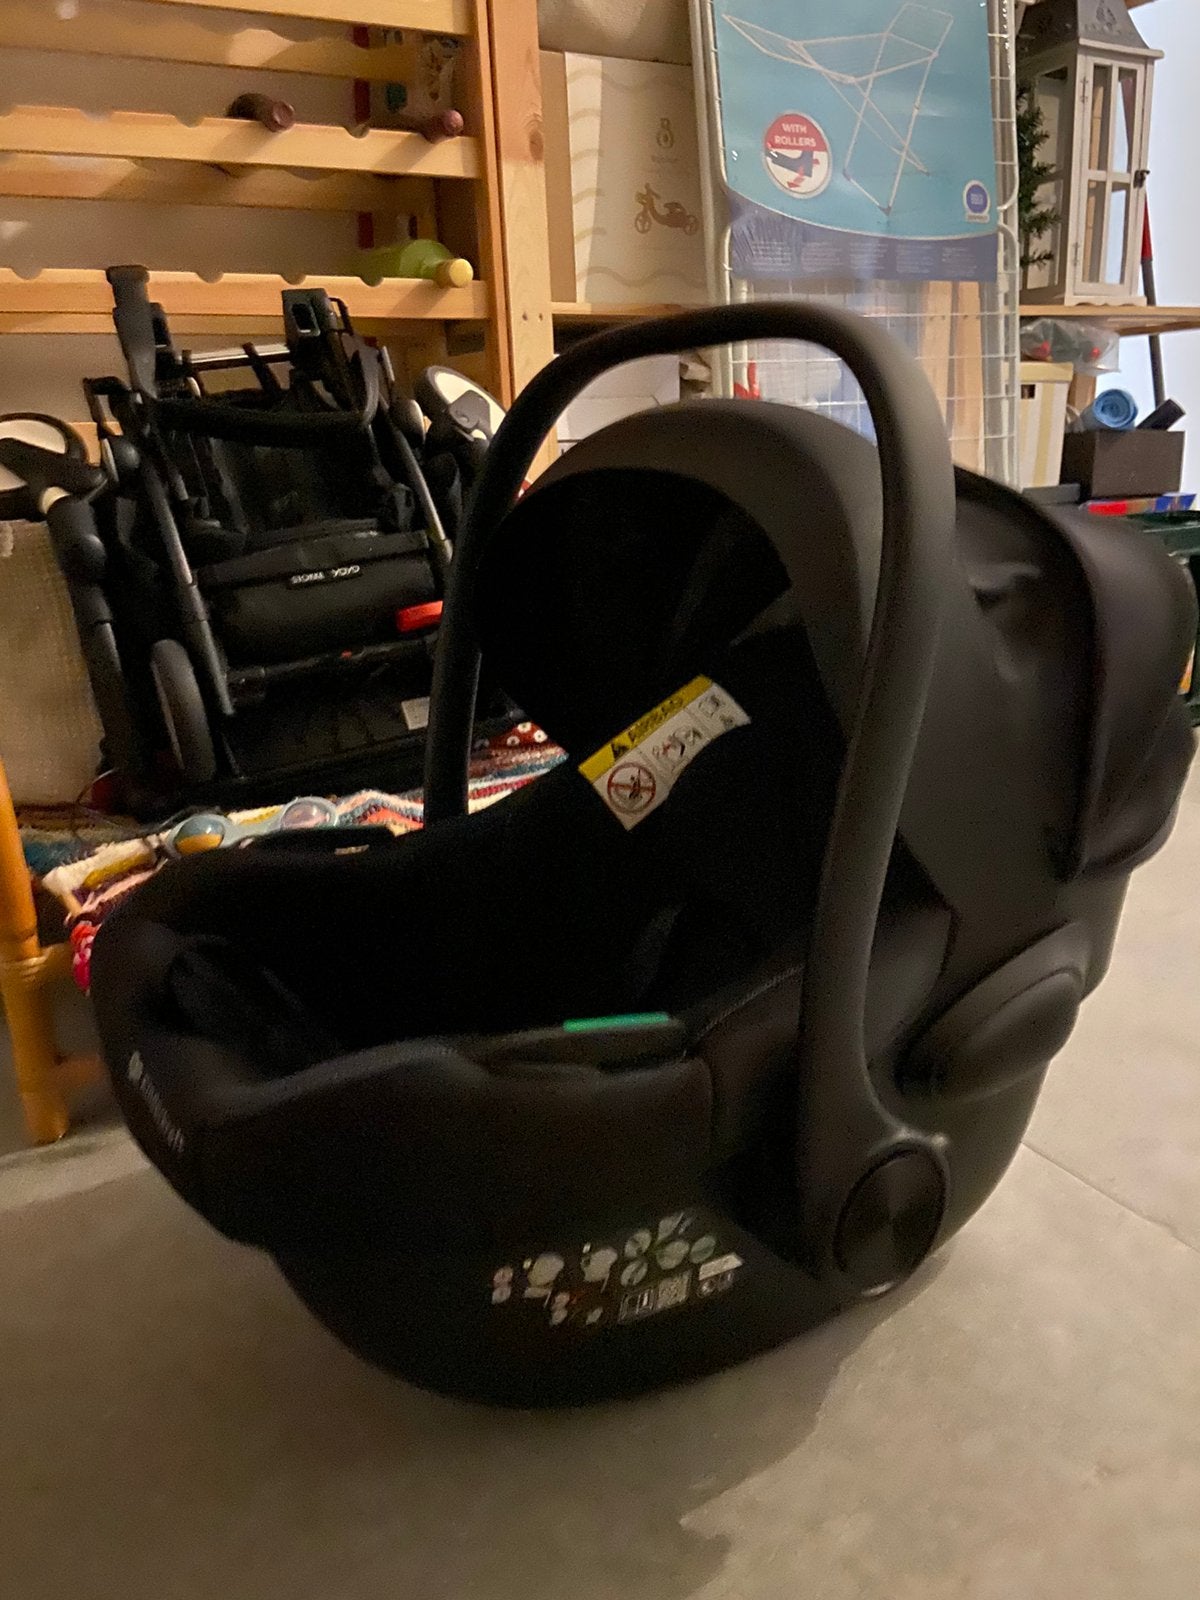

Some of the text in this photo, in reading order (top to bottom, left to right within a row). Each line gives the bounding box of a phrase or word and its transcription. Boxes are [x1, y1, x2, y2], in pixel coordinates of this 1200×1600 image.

[782, 123, 807, 133] WITH
[774, 135, 816, 146] ROLLERS
[331, 565, 360, 577] YOYO
